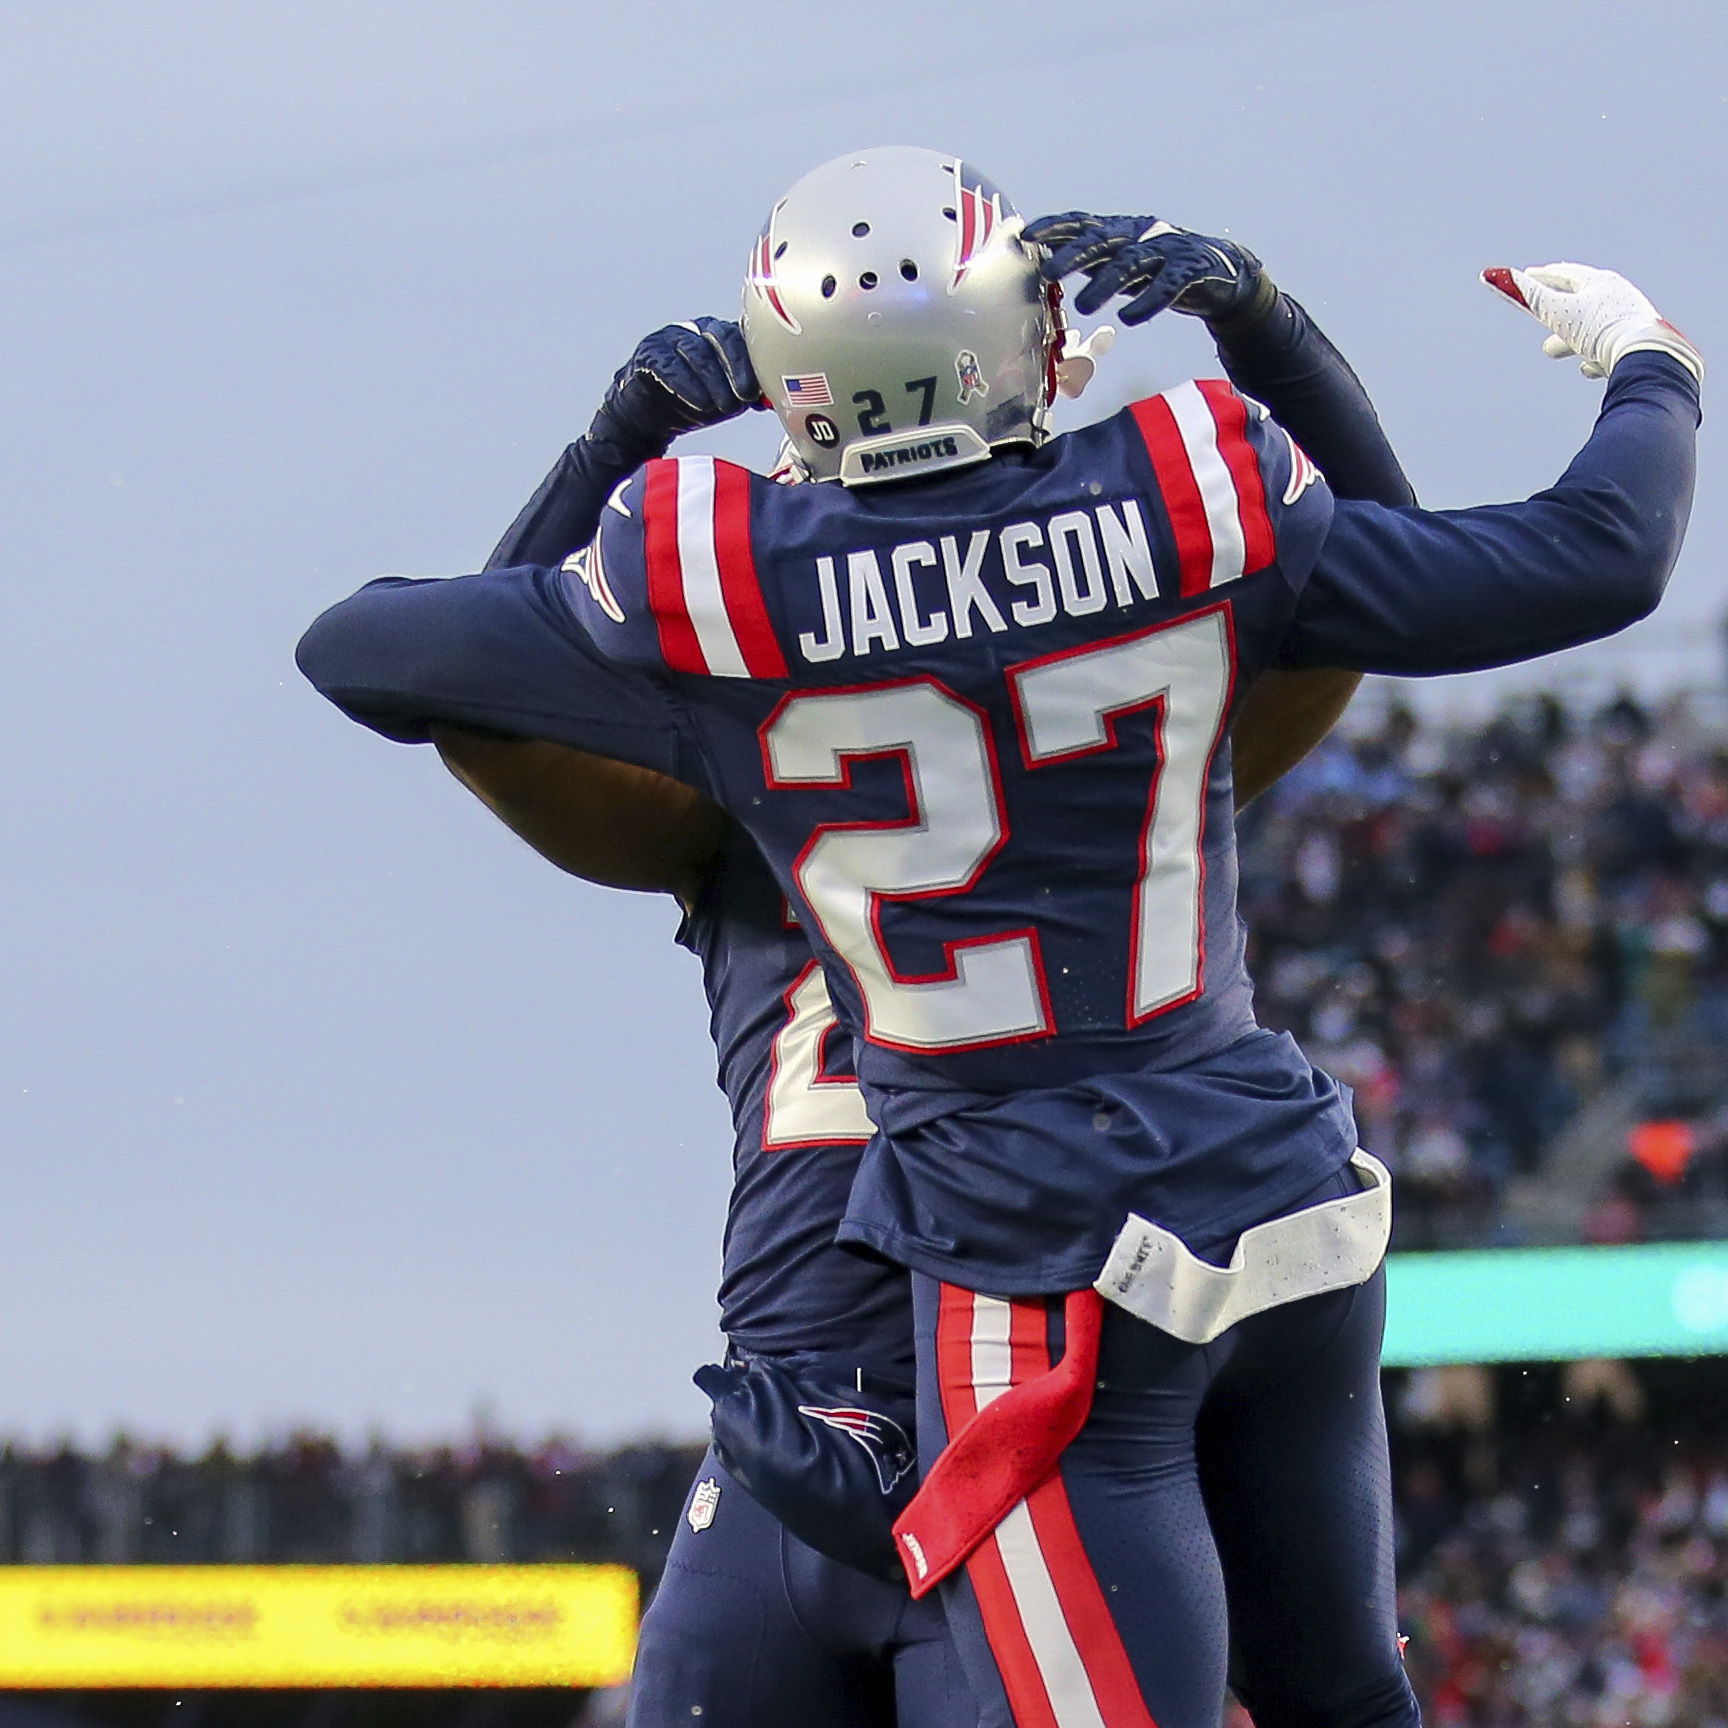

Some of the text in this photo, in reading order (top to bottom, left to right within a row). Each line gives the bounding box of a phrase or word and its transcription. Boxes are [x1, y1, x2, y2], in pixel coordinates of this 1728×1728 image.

[812, 420, 836, 442] JD
[851, 376, 938, 438] 27
[860, 437, 959, 474] PATRIOTS
[798, 499, 1160, 664] JACKSON
[756, 599, 1239, 1058] 27
